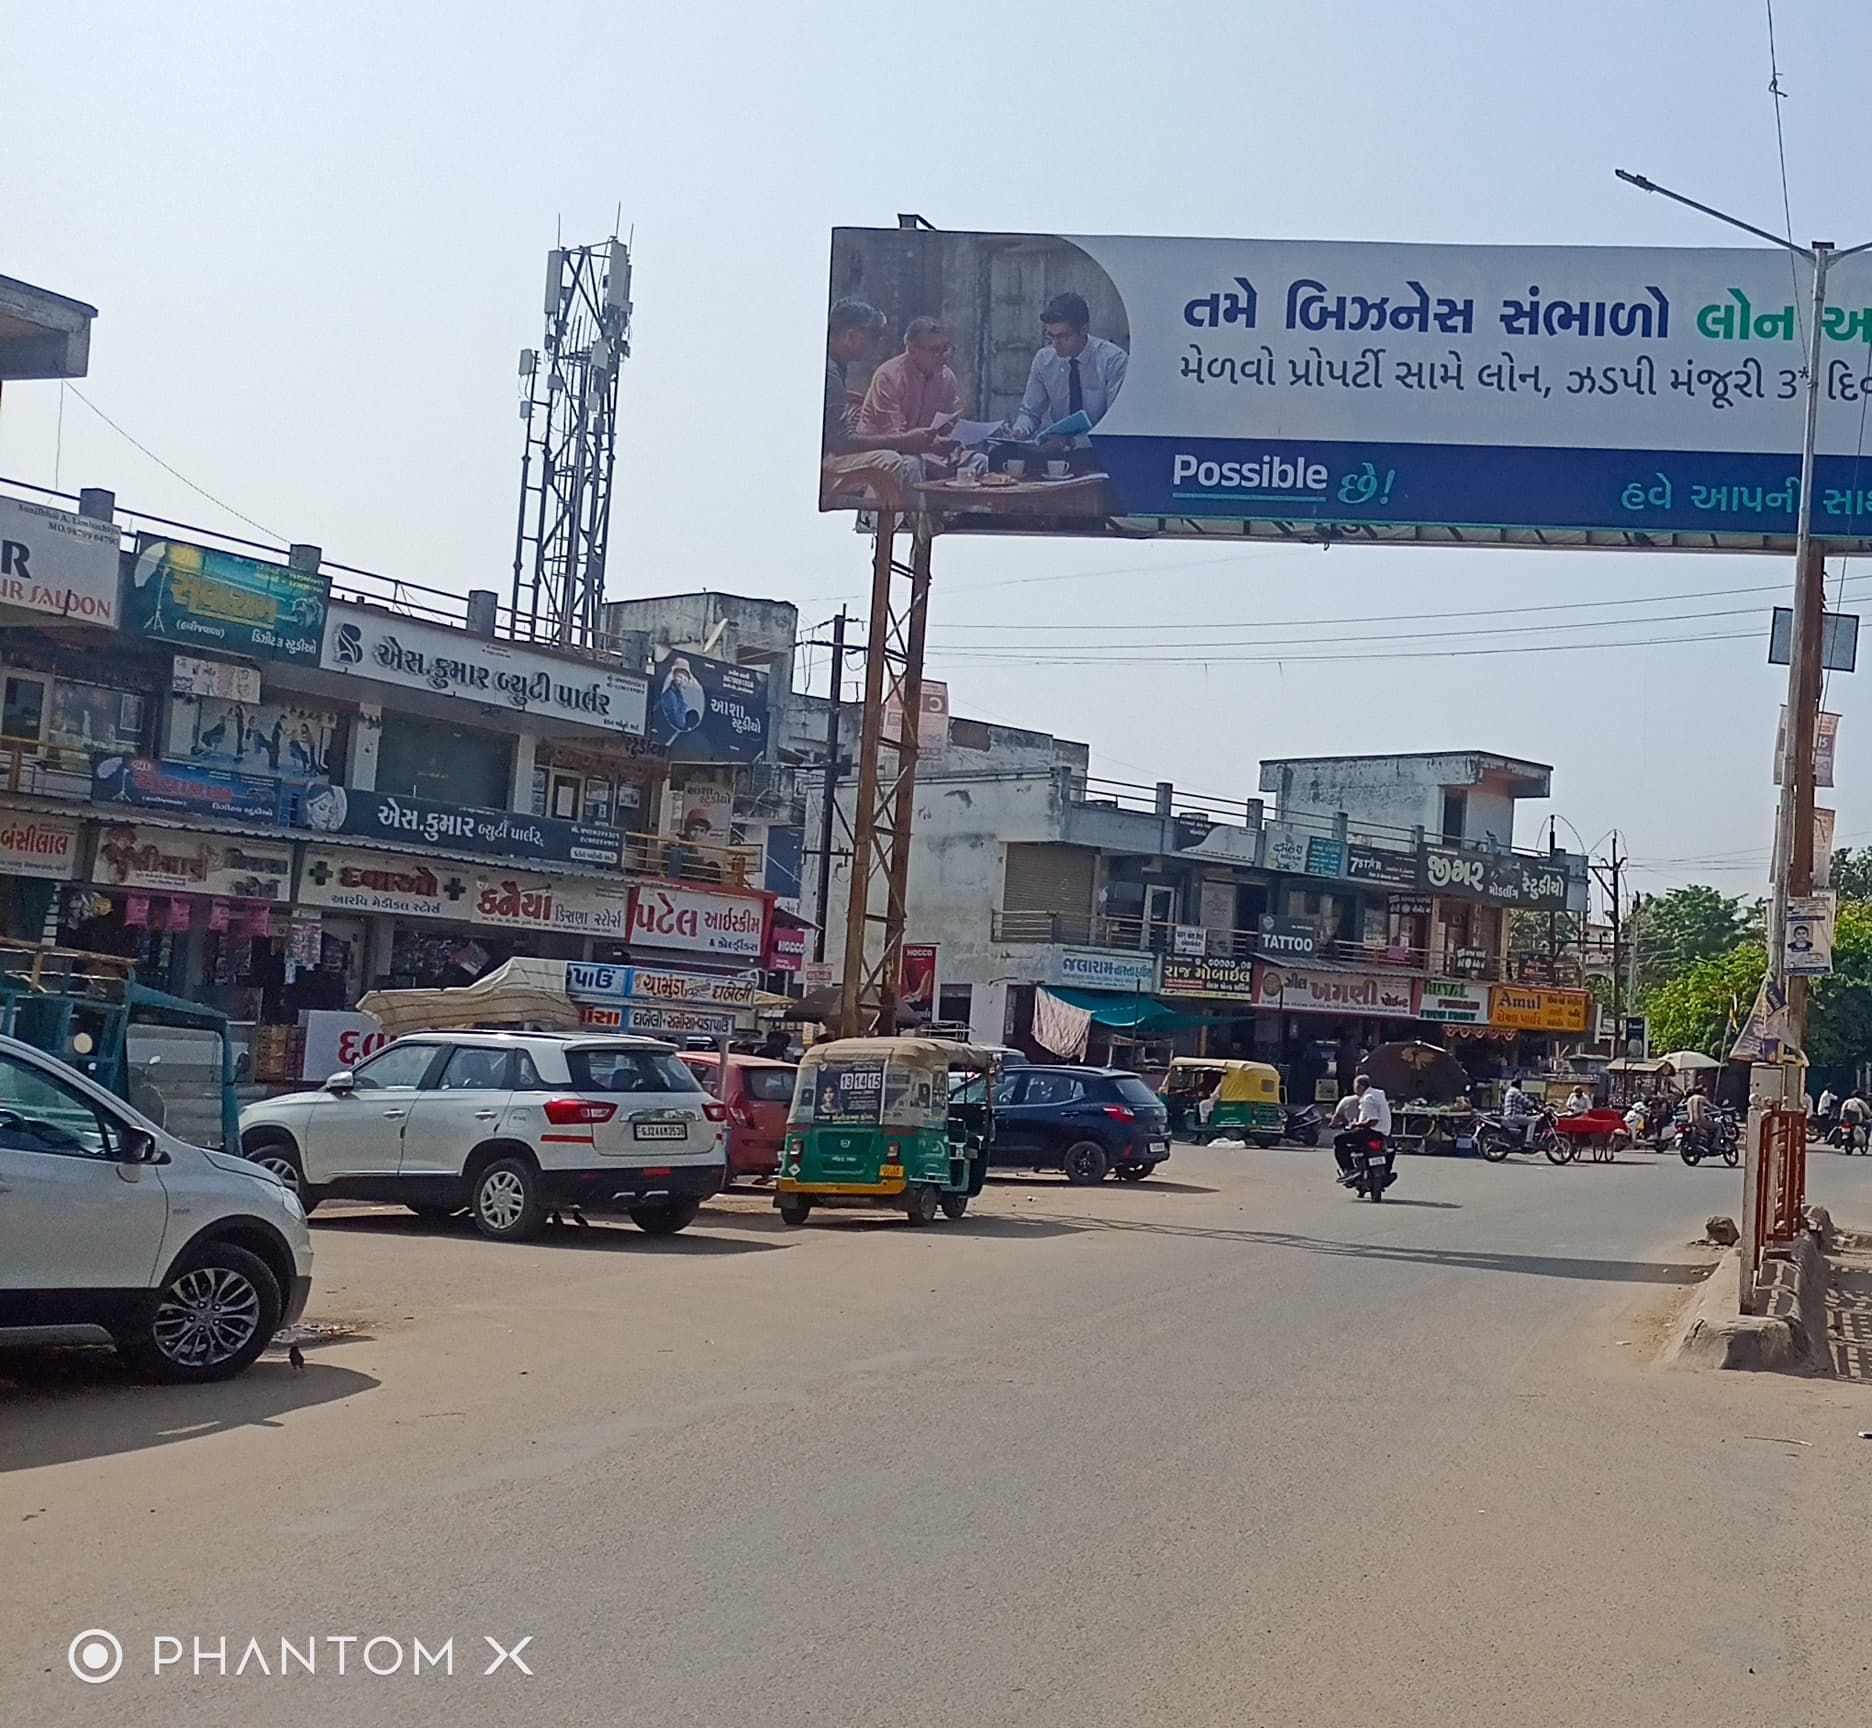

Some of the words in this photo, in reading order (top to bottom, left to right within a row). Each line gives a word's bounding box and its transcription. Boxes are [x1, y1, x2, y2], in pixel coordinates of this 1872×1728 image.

[1184, 278, 1258, 330] તમે
[1285, 278, 1474, 334] બિઝનેસ
[1500, 286, 1670, 338] સંભાળો
[1698, 288, 1794, 341] લોન
[1181, 346, 1275, 385] મેળવો
[1288, 347, 1385, 389] પ્રોપર્ટી
[1395, 352, 1464, 391] સામે
[1478, 353, 1552, 398] લોન,
[1567, 355, 1656, 396] ઝડપી
[1671, 357, 1764, 408] મંજૂરી
[1173, 454, 1326, 490] Possible
[1337, 462, 1396, 505] છે!
[1622, 473, 1672, 512] હવે
[1691, 477, 1802, 513] આપની
[29, 585, 111, 618] SALOON
[374, 635, 489, 689] એસ.કુમાર
[494, 671, 550, 706] બ્યુટી
[555, 683, 610, 715] પાર્લર
[710, 698, 744, 718] આશા
[377, 798, 475, 841] એસ.કુમાર
[1, 822, 68, 855] બંસીલાલ
[1427, 856, 1484, 891] જીગર
[636, 892, 698, 937] પટેલ
[1262, 934, 1313, 951] TATTOO
[1063, 958, 1113, 974] જલારામ
[1164, 965, 1191, 977] રાજ
[1499, 991, 1541, 1009] Amul
